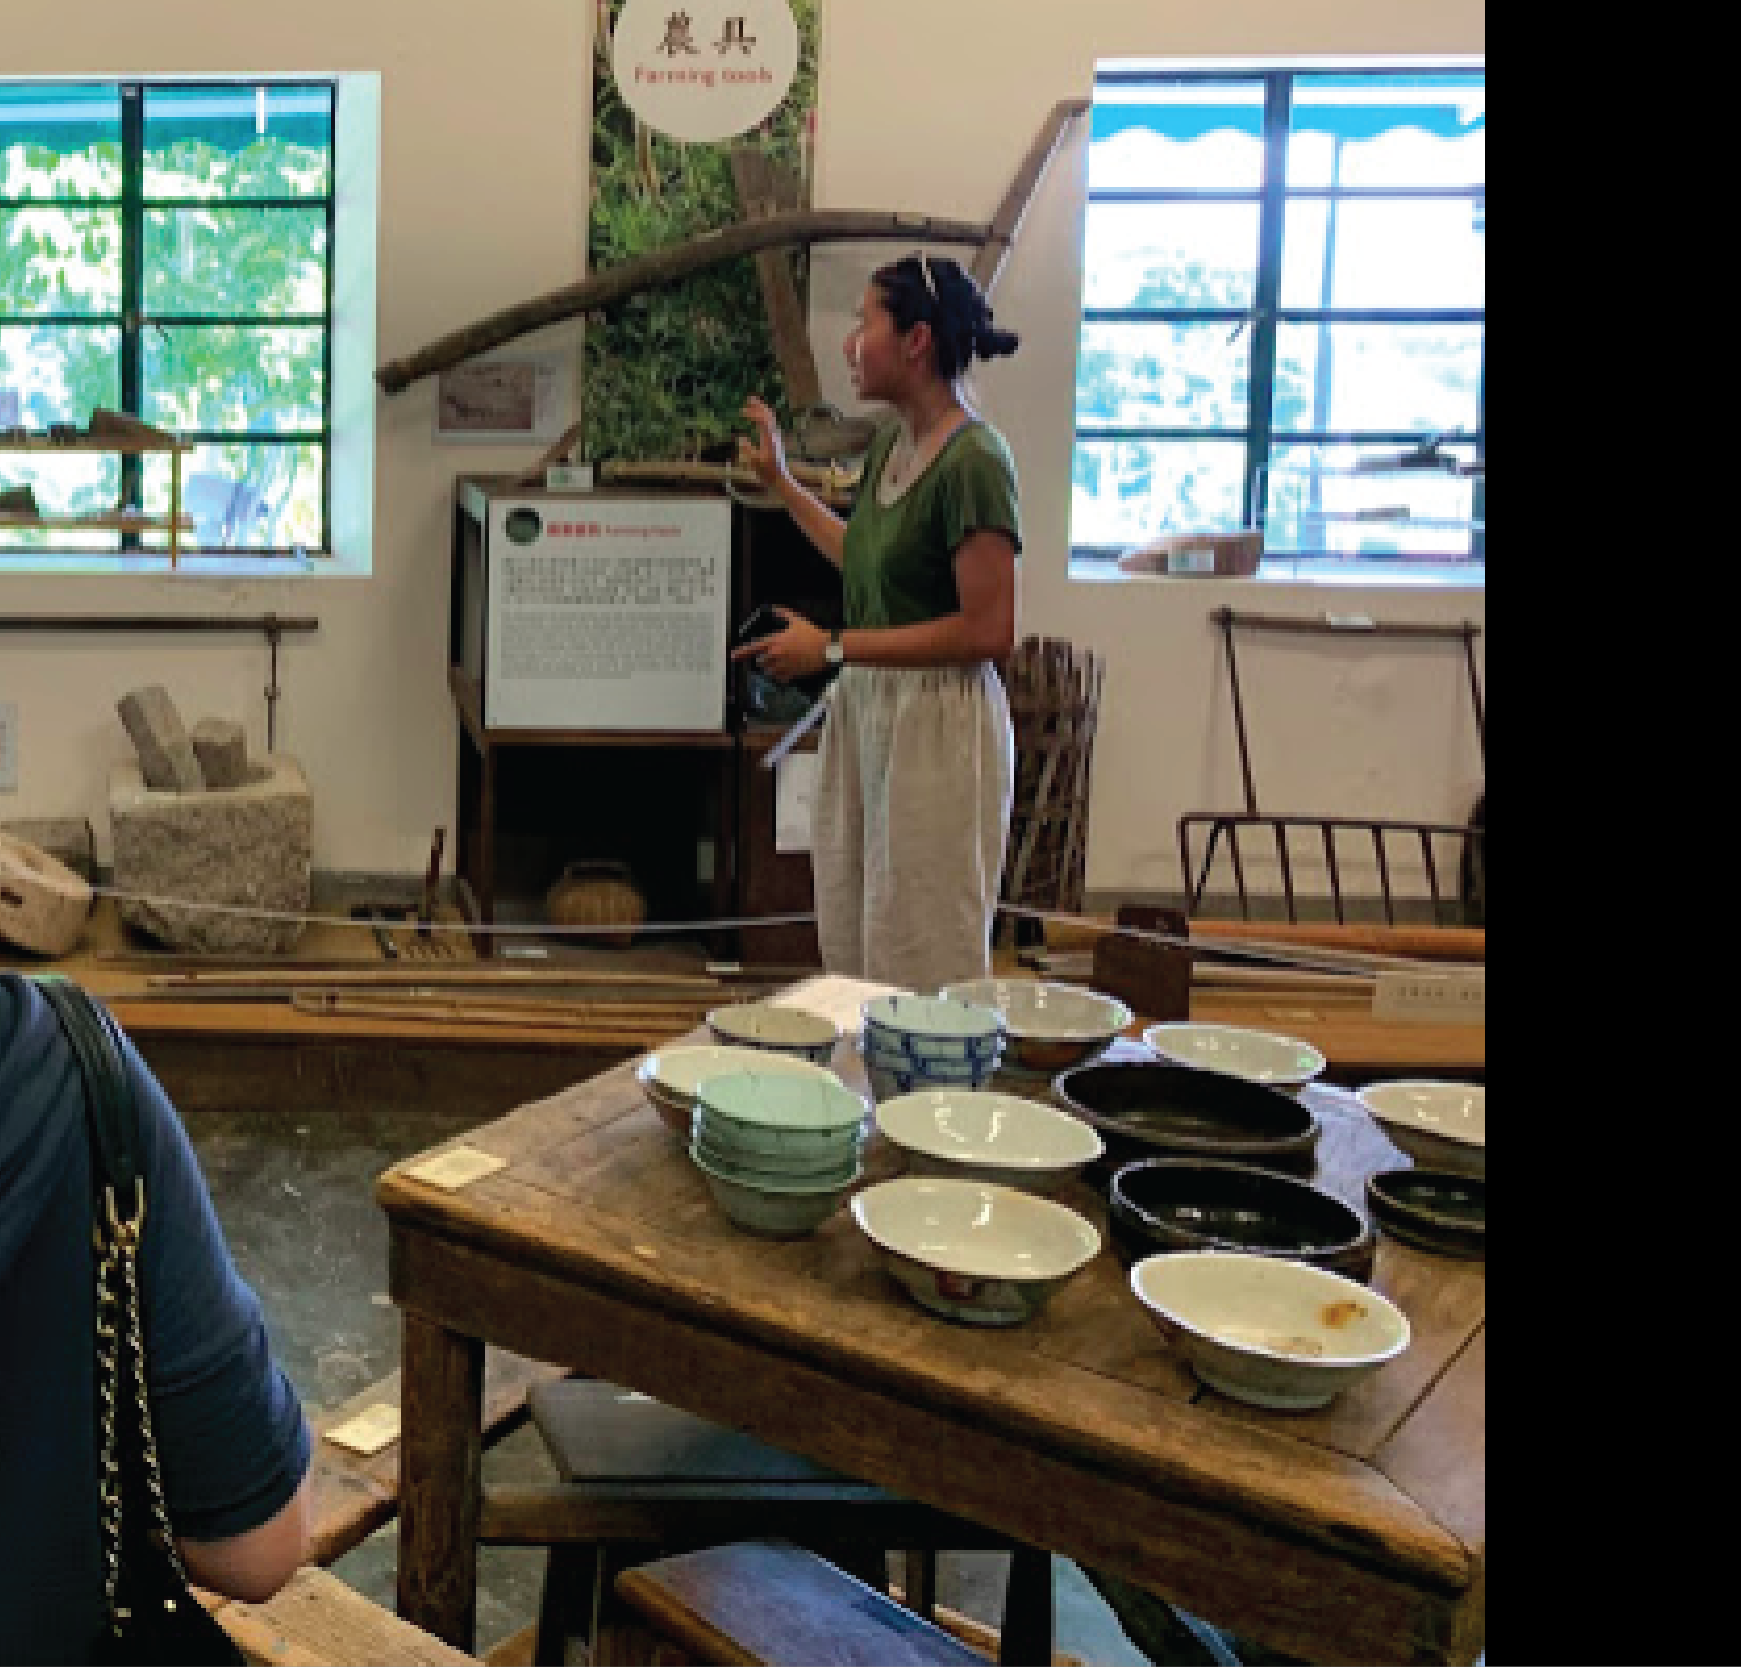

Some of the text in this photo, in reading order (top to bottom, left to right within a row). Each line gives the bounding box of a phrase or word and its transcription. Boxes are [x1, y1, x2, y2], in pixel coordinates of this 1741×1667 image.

[656, 8, 757, 58] 農具
[634, 64, 773, 88] Farming tools
